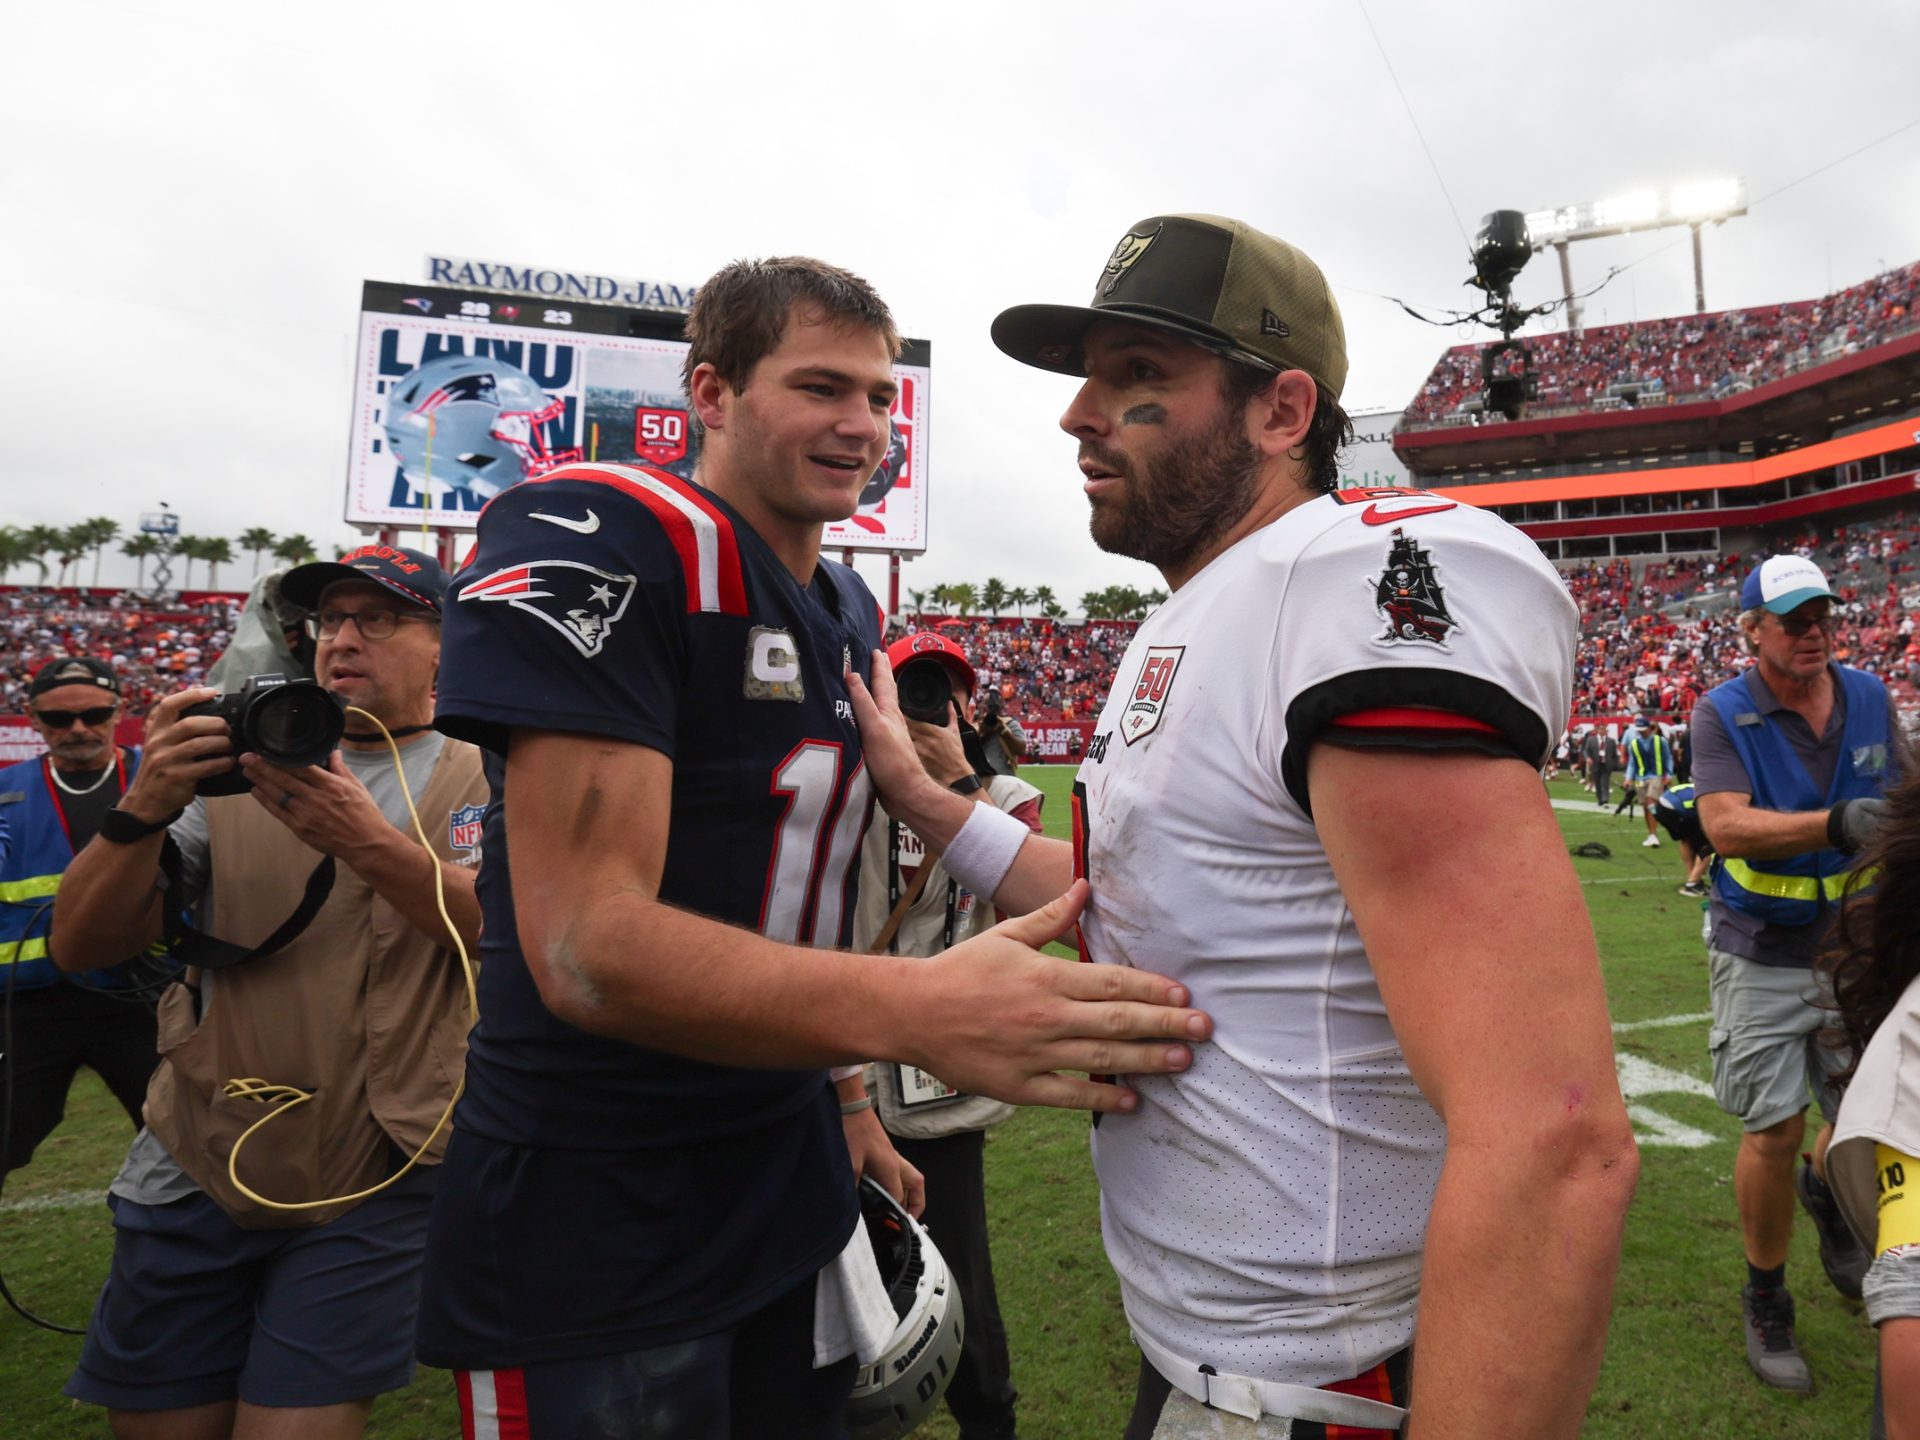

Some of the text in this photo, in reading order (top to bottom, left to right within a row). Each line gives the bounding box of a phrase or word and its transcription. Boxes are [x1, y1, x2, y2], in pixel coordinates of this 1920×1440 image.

[429, 257, 618, 301] RAYMOND
[543, 309, 572, 325] 23
[641, 413, 682, 441] 50
[752, 633, 799, 682] C
[1135, 657, 1174, 702] 50
[1036, 729, 1046, 741] A
[1038, 743, 1067, 755] DEAN
[1885, 1162, 1905, 1189] 10
